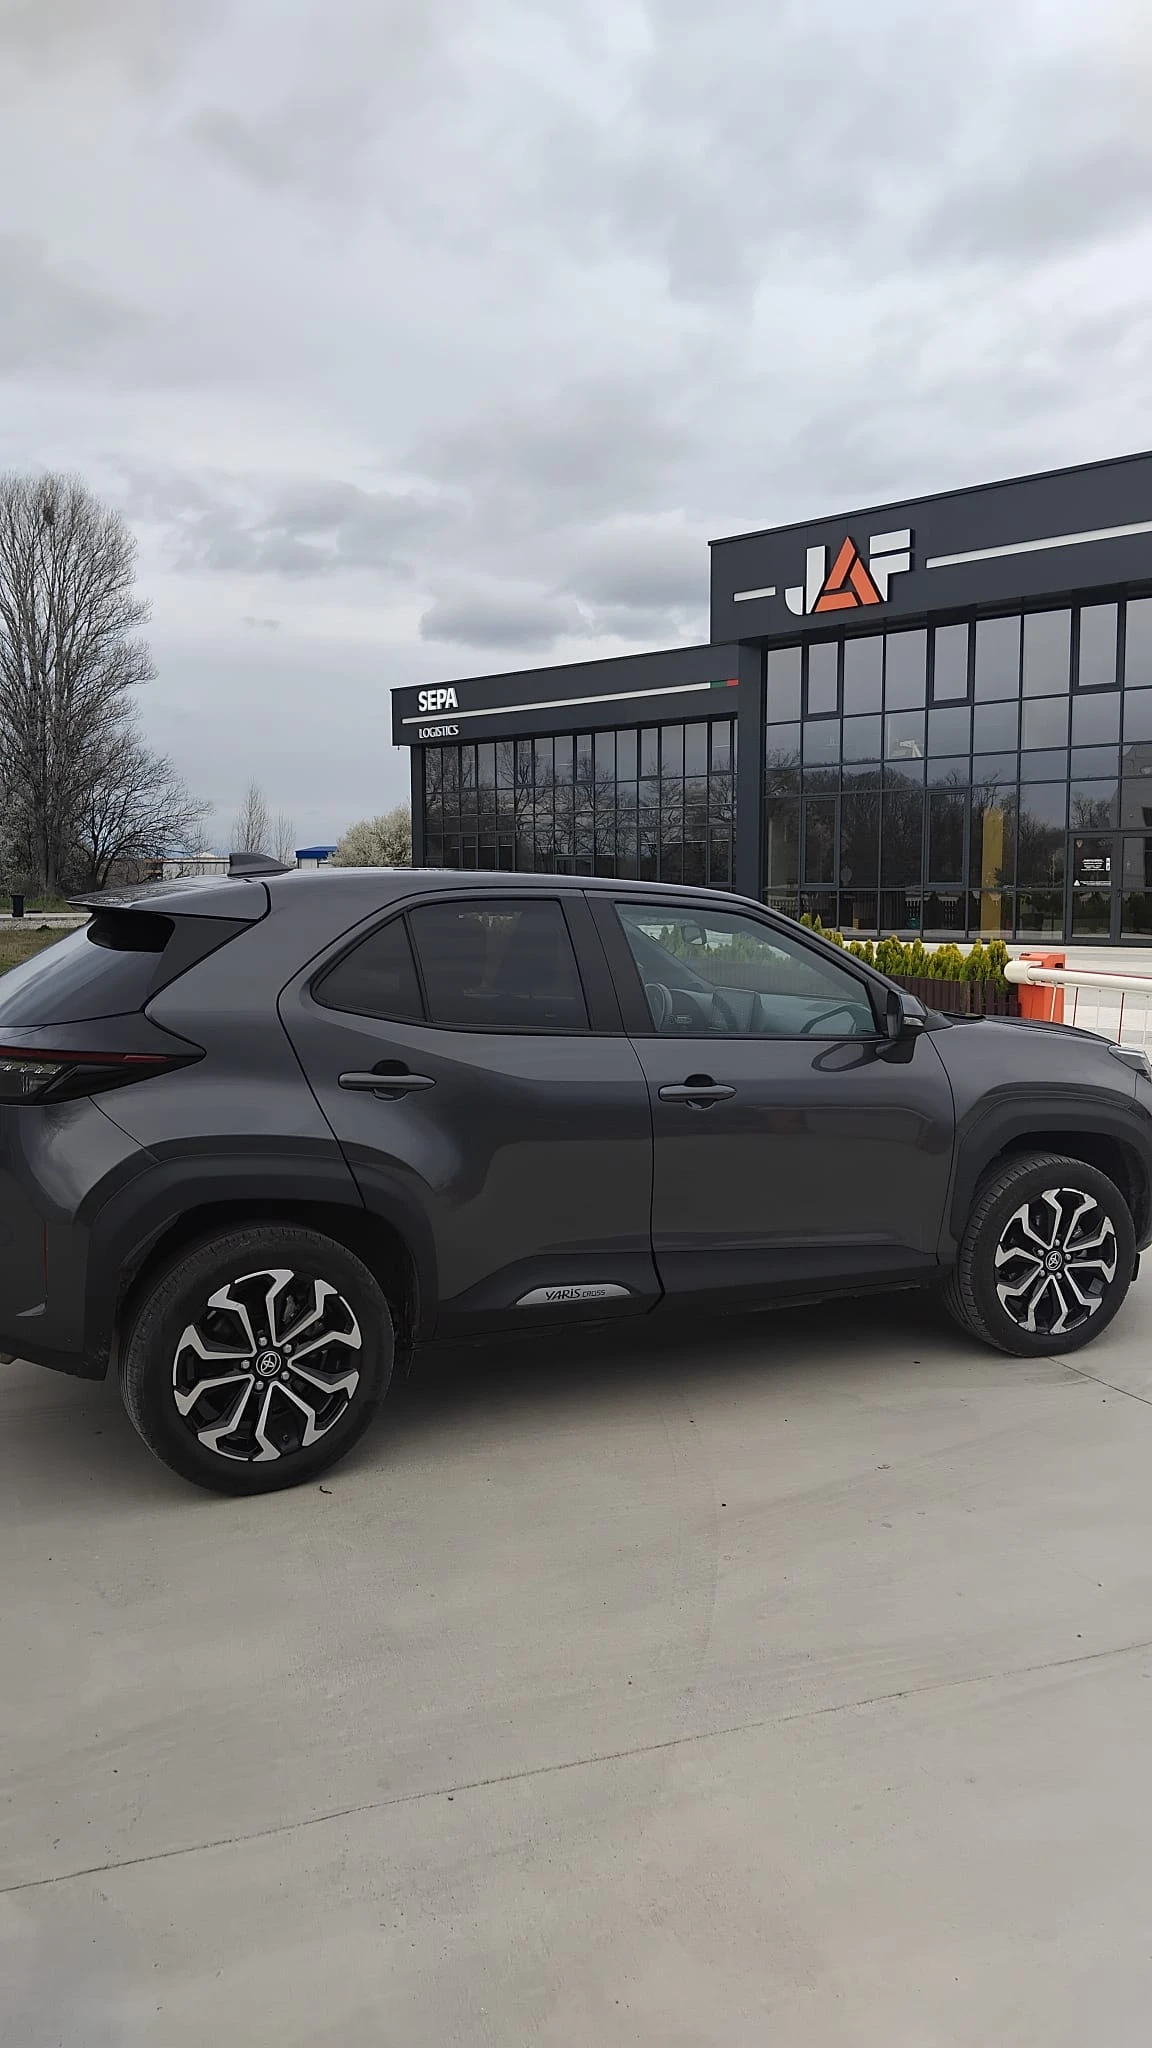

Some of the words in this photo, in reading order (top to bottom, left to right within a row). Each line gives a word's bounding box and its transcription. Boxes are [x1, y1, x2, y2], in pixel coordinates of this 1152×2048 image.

[785, 528, 911, 616] JAF
[418, 687, 459, 712] SEPA
[418, 724, 460, 739] LOGISTICS
[582, 1289, 606, 1298] CROSS
